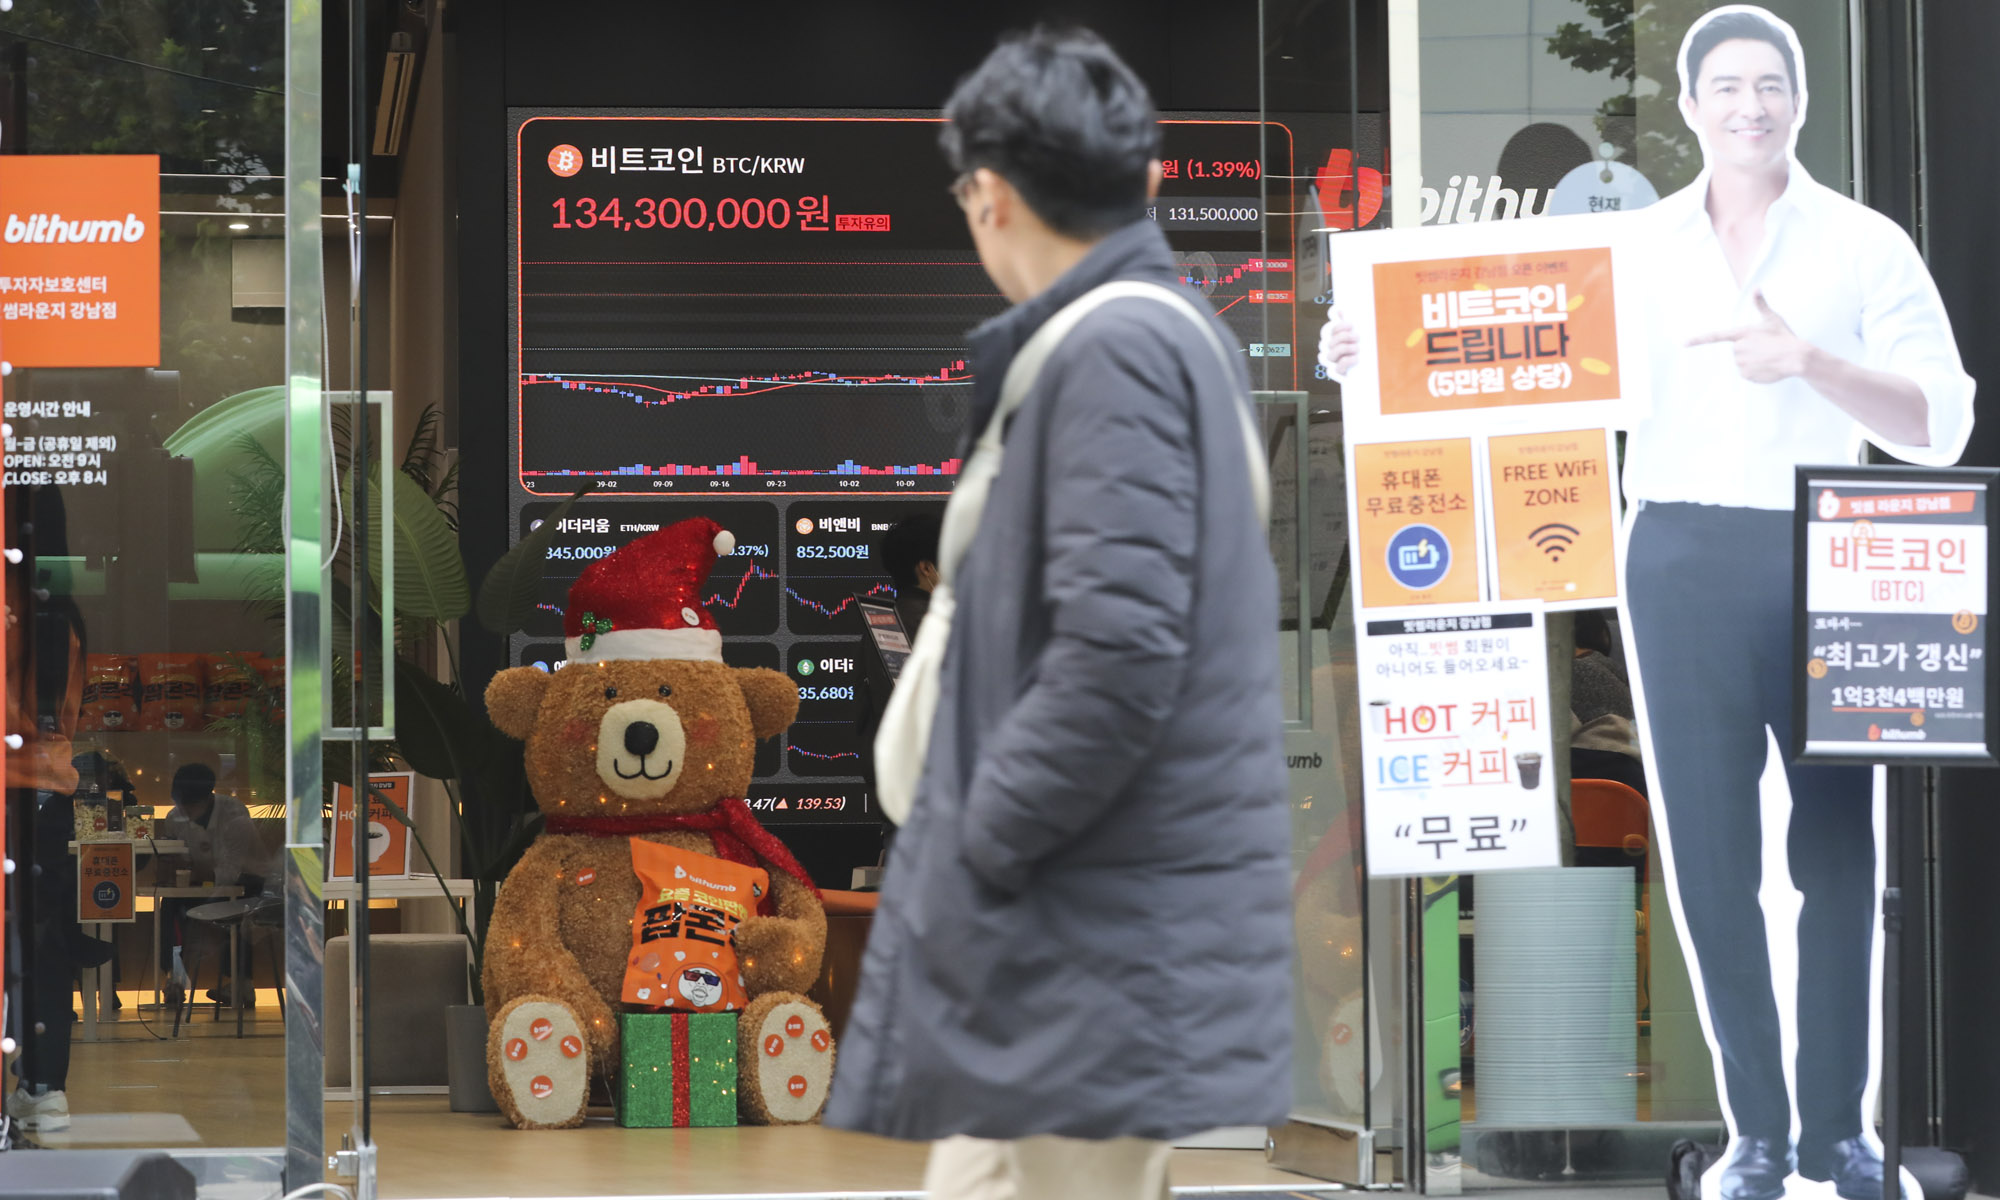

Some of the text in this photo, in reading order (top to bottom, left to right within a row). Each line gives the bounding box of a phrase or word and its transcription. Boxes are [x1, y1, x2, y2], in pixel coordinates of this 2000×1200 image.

[591, 145, 806, 176] 비트코인 BTC/KRW
[1187, 159, 1261, 180] (1.39%)
[552, 194, 889, 232] 134,300,000원 투자유의
[1169, 207, 1259, 222] 131,500,000
[4, 212, 146, 243] bithumb
[0, 275, 107, 294] 투자자보호센터
[70, 301, 117, 320] 강남점
[1421, 282, 1569, 330] 비트코인
[1426, 322, 1570, 366] 드립니다
[1427, 361, 1573, 398] (5만원 상당)
[4, 400, 91, 418] 운영시간 안내
[38, 436, 82, 452] (공휴일
[85, 436, 117, 452] 제외)
[3, 454, 46, 468] OPEN:
[48, 453, 75, 469] 오전
[1503, 458, 1598, 482] FREE WiFi
[4, 471, 52, 485] CLOSE:
[54, 470, 81, 486] 오후
[710, 480, 730, 488] 09-16
[766, 480, 787, 488] 09-23
[839, 480, 860, 488] 10-02
[895, 480, 915, 488] 10-09
[1381, 467, 1441, 491] 휴대폰
[1365, 492, 1468, 518] 무료충전소
[1523, 486, 1580, 507] ZONE
[620, 523, 661, 533] ETH/KRW
[818, 517, 861, 533] 비앤비
[796, 544, 870, 560] 852,500원
[1829, 535, 1966, 575] 비트코인
[1376, 660, 1438, 678] 아니어도
[1831, 685, 1964, 709] 1억3천4백만원
[1385, 697, 1536, 735] HOT 커피
[1378, 747, 1509, 785] ICE 커피
[796, 795, 847, 811] 139.53)
